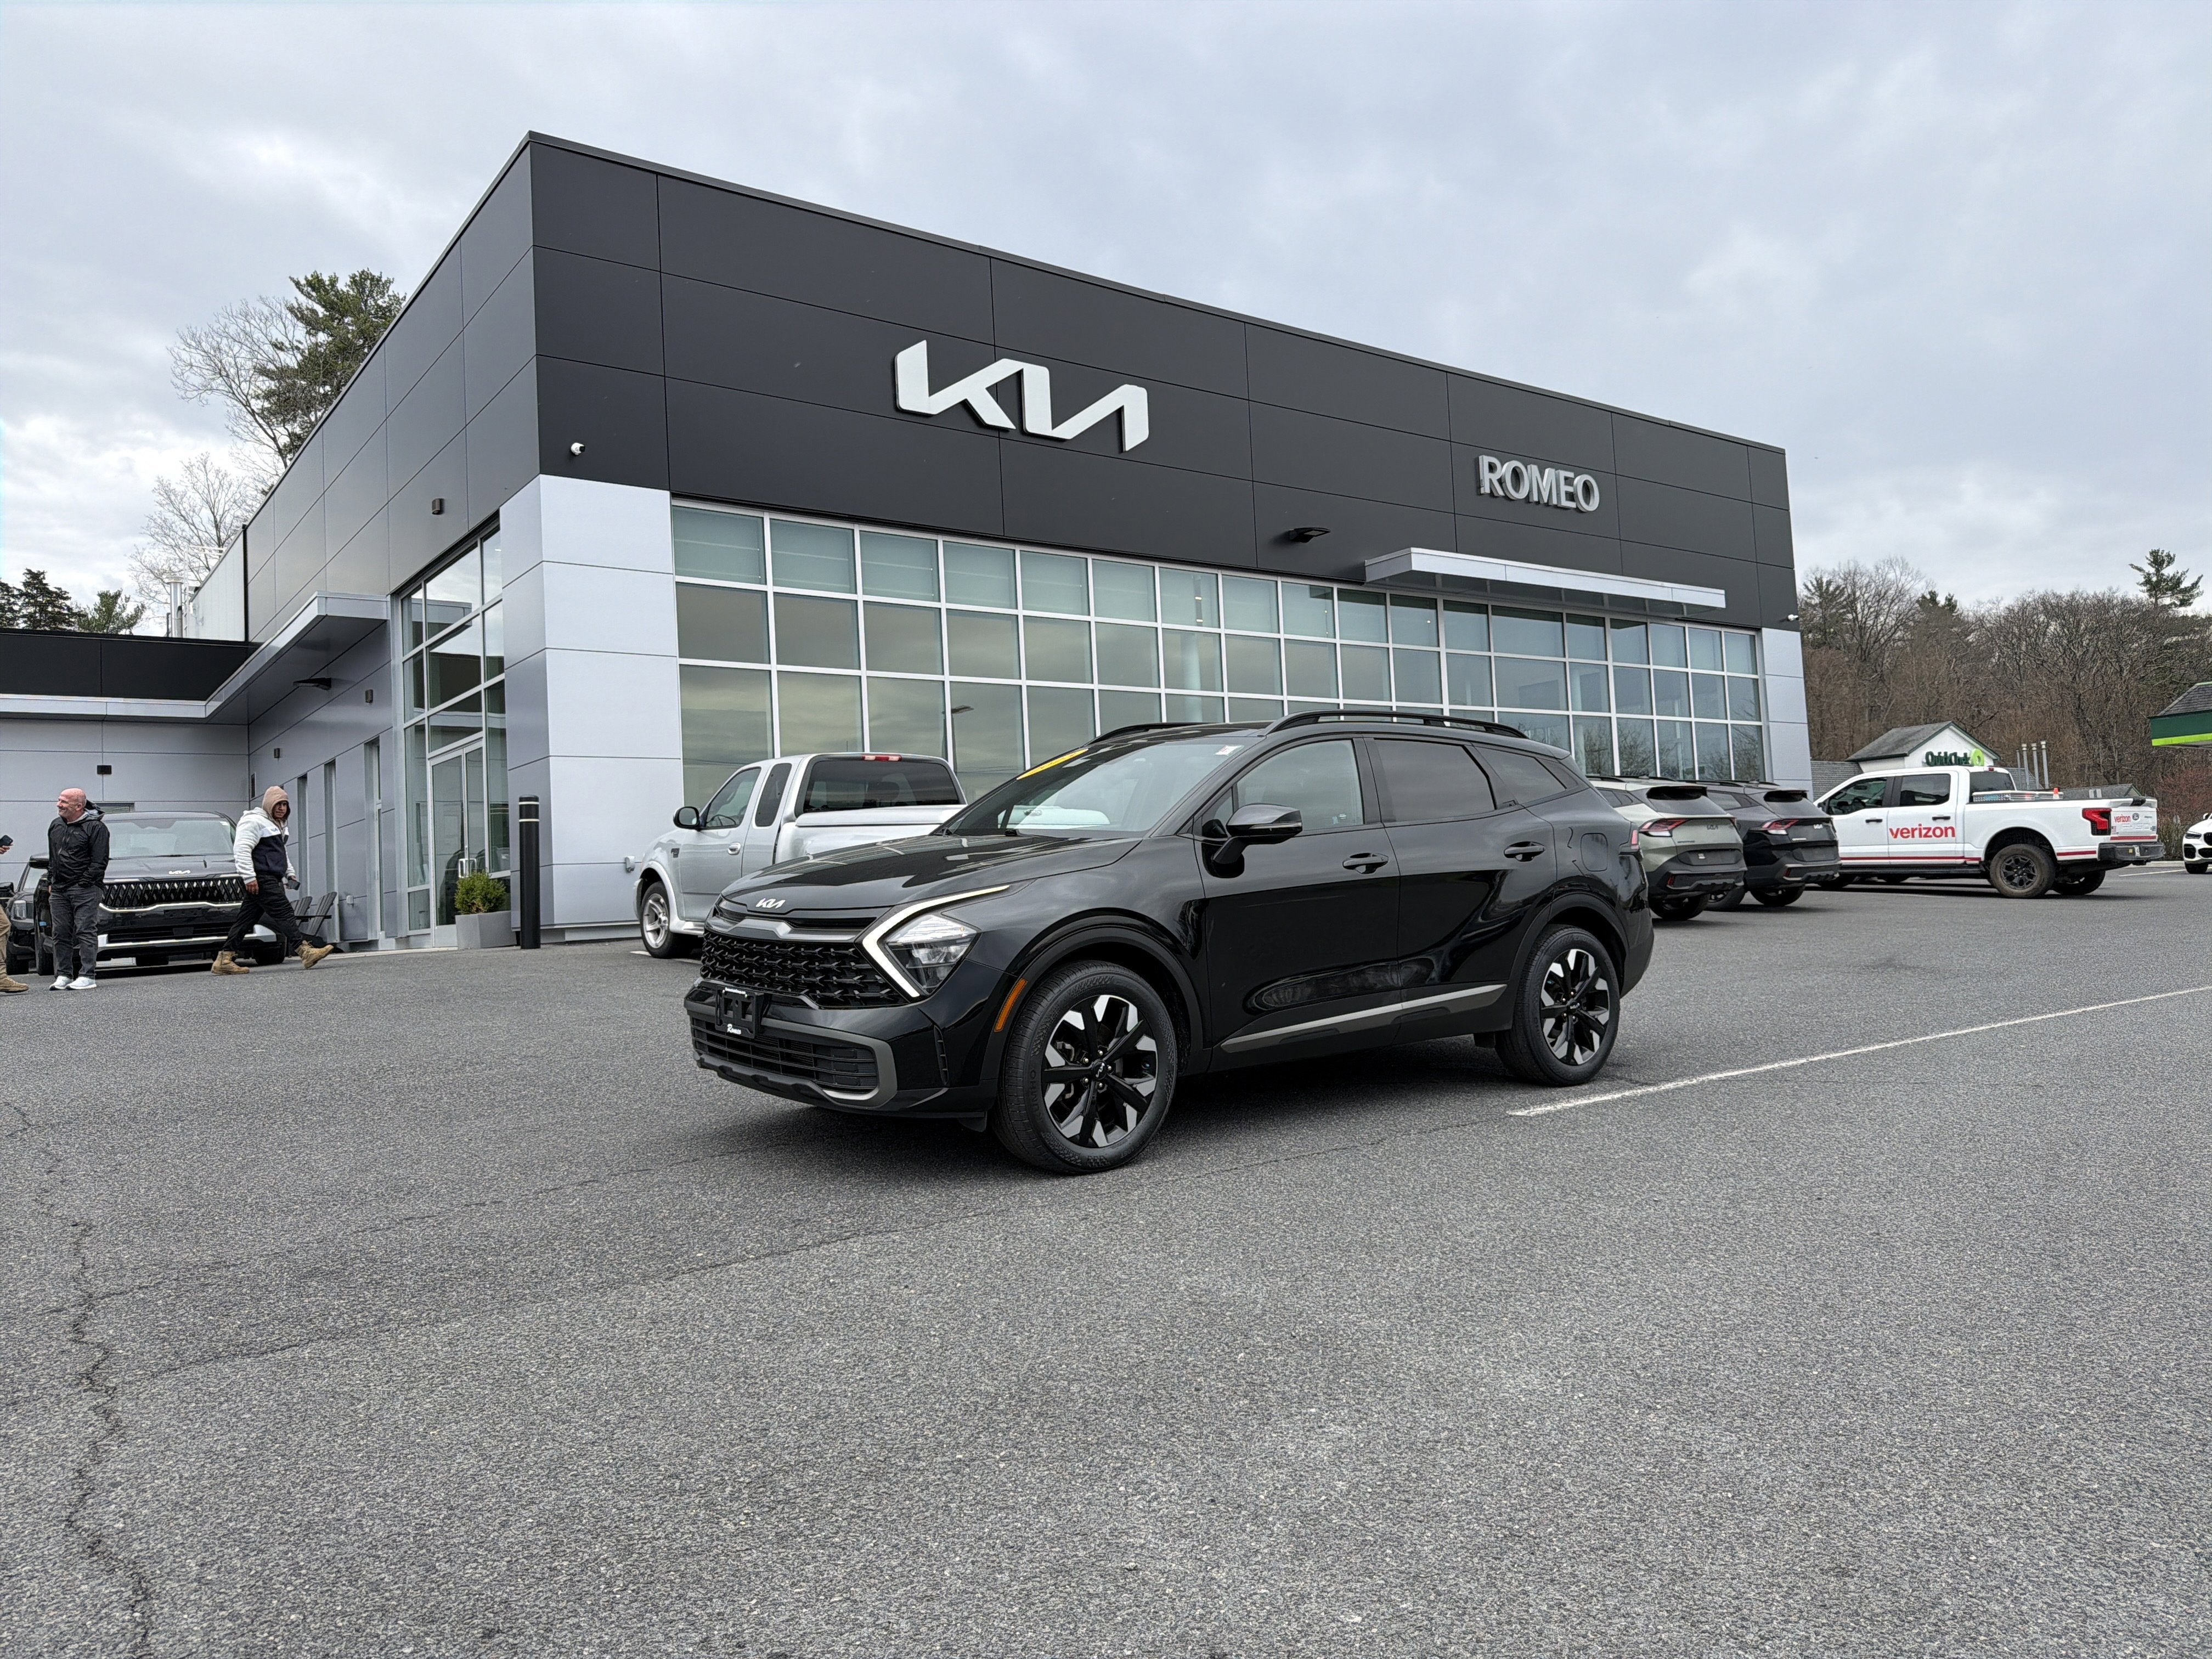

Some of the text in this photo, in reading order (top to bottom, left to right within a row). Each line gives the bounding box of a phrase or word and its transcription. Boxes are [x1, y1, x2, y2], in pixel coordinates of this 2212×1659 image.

[1478, 455, 1600, 512] ROMEO
[2114, 814, 2131, 823] verizon
[1889, 823, 1956, 839] verizon
